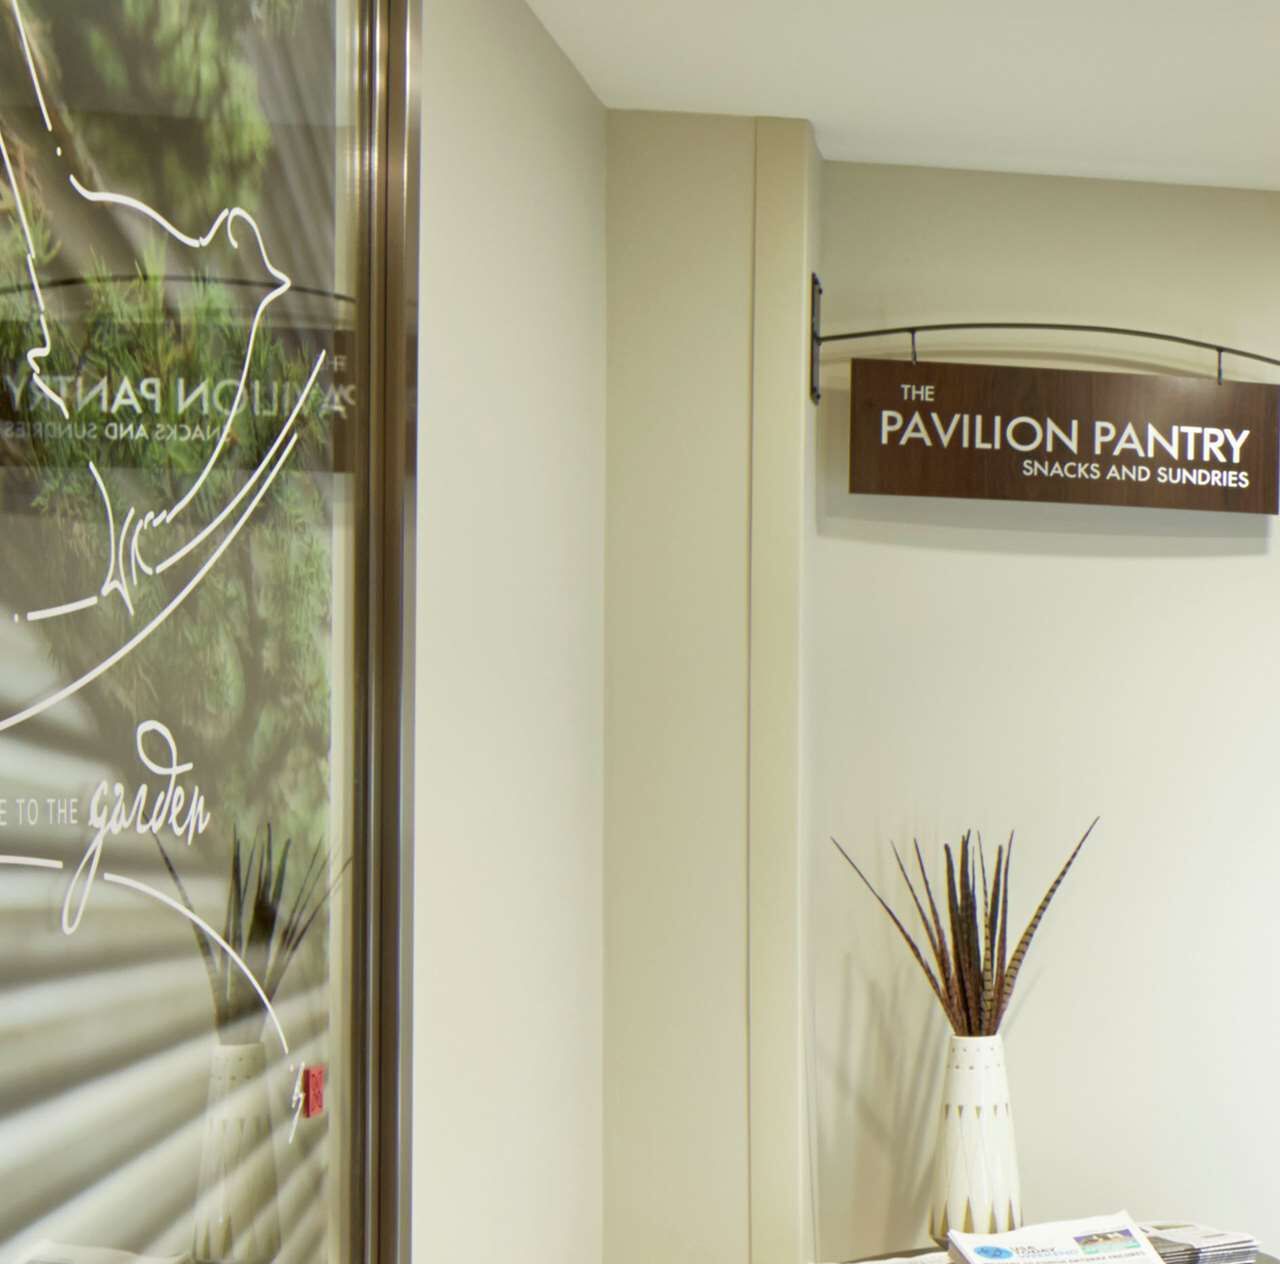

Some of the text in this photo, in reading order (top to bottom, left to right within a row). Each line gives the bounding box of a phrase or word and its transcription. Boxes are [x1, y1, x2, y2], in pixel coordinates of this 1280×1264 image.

[901, 383, 935, 402] THE
[880, 410, 1251, 465] PAVILION PANTRY
[1022, 459, 1250, 489] SNACKS AND SUNDRIES
[16, 798, 39, 826] TO
[47, 798, 78, 825] THE
[62, 719, 211, 935] garden
